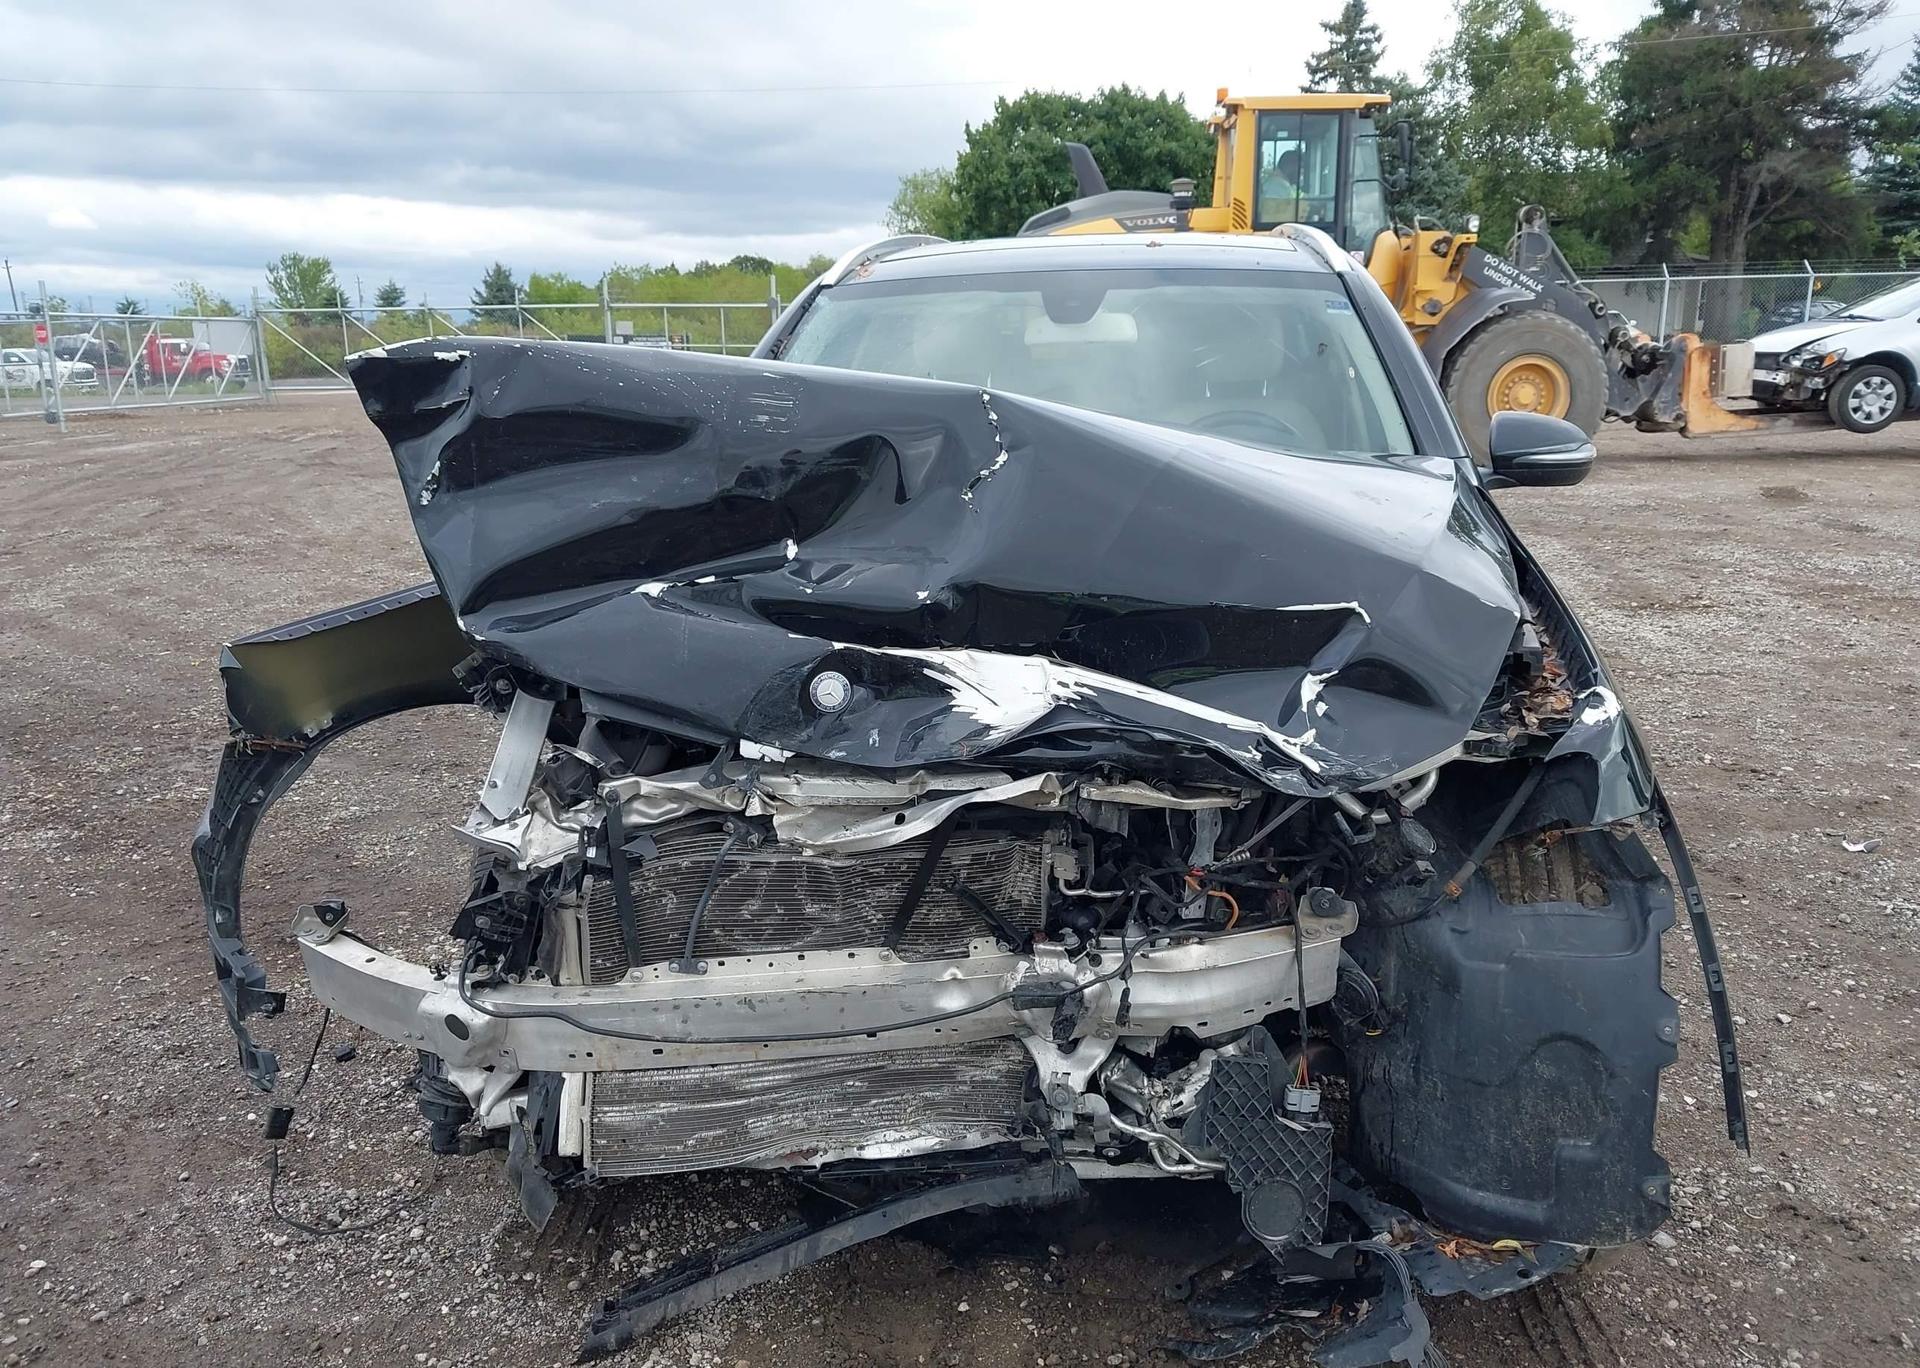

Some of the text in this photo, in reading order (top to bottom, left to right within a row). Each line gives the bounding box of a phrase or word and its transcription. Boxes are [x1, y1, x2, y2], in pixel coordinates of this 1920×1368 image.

[1483, 266, 1513, 288] UNDER
[1484, 254, 1499, 266] DO
[1498, 262, 1519, 277] NOT
[1519, 273, 1544, 293] WALK
